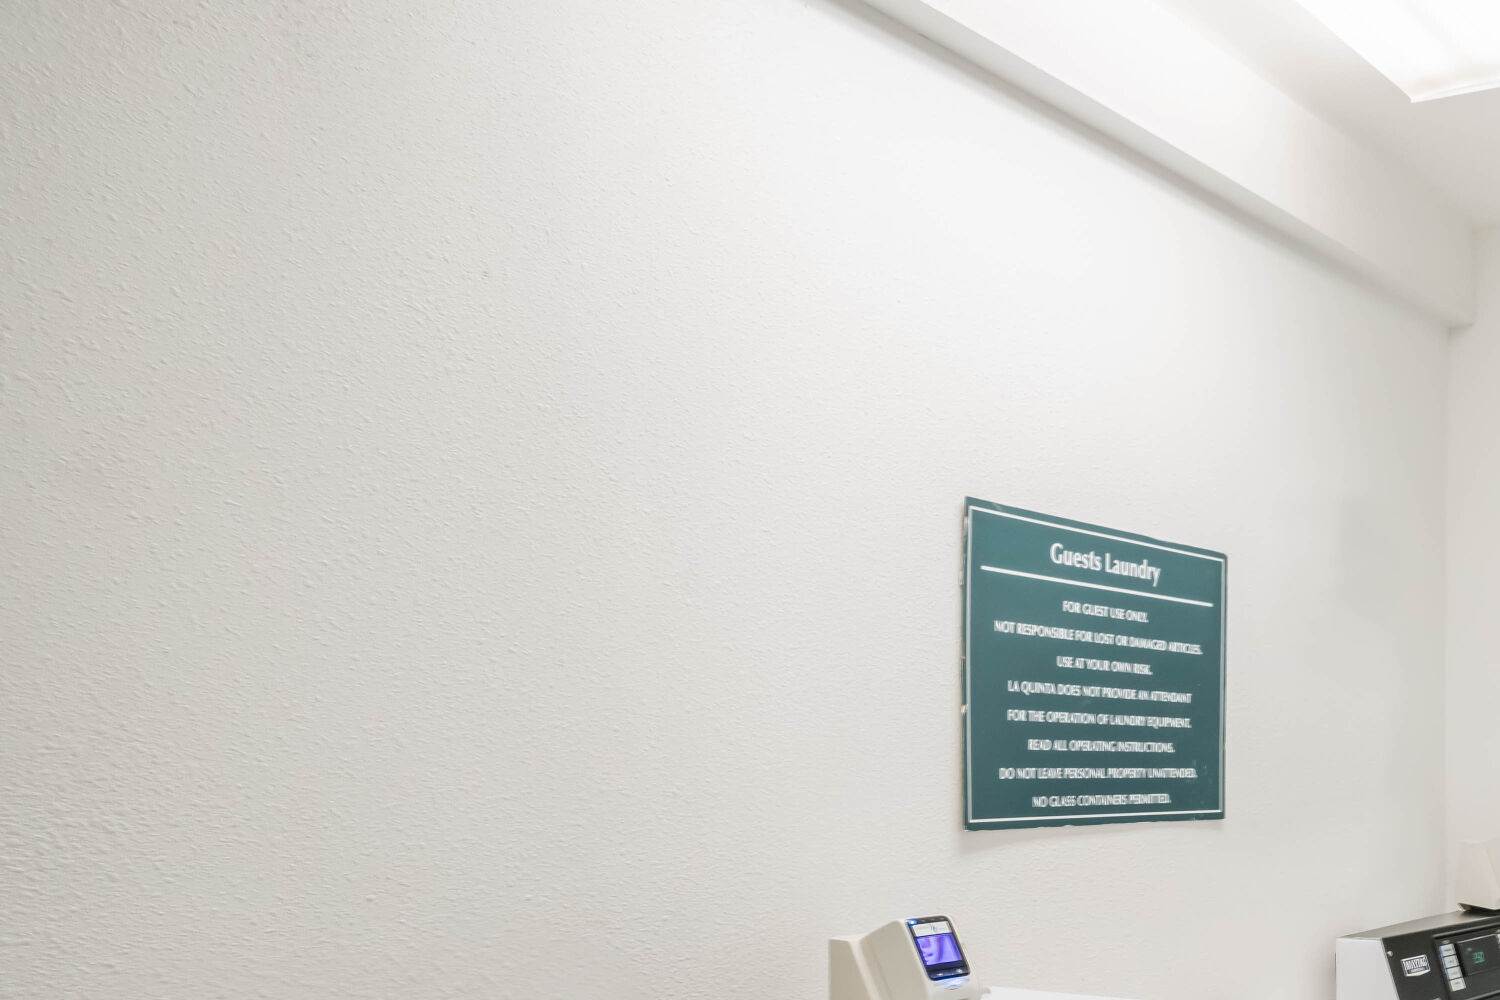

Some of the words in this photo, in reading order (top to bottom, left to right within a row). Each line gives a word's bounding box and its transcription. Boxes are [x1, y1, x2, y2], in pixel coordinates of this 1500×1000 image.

[1050, 543, 1102, 571] Guests
[1105, 553, 1161, 587] Laundry
[1062, 600, 1081, 613] FOR
[1082, 604, 1109, 617] GUEST
[1110, 608, 1125, 620] USE
[994, 620, 1016, 633] NOT
[1016, 622, 1074, 640] RESPONSIBLE
[1075, 630, 1093, 642] FOR
[1094, 632, 1115, 645] LOST
[1115, 634, 1128, 646] OR
[1056, 655, 1074, 668] USE
[1074, 657, 1085, 669] AT
[1086, 659, 1110, 671] YOUR
[1111, 661, 1132, 673] OWN
[1007, 680, 1020, 692] LA
[1020, 681, 1056, 695] QUINTA
[1057, 684, 1081, 696] DOES
[1082, 686, 1101, 698] NOT
[1101, 687, 1137, 700] PROVIDE
[1007, 709, 1027, 722] FOR
[1028, 710, 1046, 722] THE
[1046, 711, 1096, 724] OPERATION
[1096, 713, 1109, 725] OF
[1109, 714, 1146, 727] LAUNDRY
[1027, 739, 1052, 751] READ
[1052, 740, 1068, 751] ALL
[1068, 740, 1117, 752] OPERATING
[998, 767, 1016, 780] DO
[1016, 767, 1037, 779] NOT
[1037, 767, 1063, 779] LEAVE
[1064, 767, 1106, 779] PERSONAL
[1032, 796, 1048, 807] NO
[1048, 795, 1077, 807] GLASS
